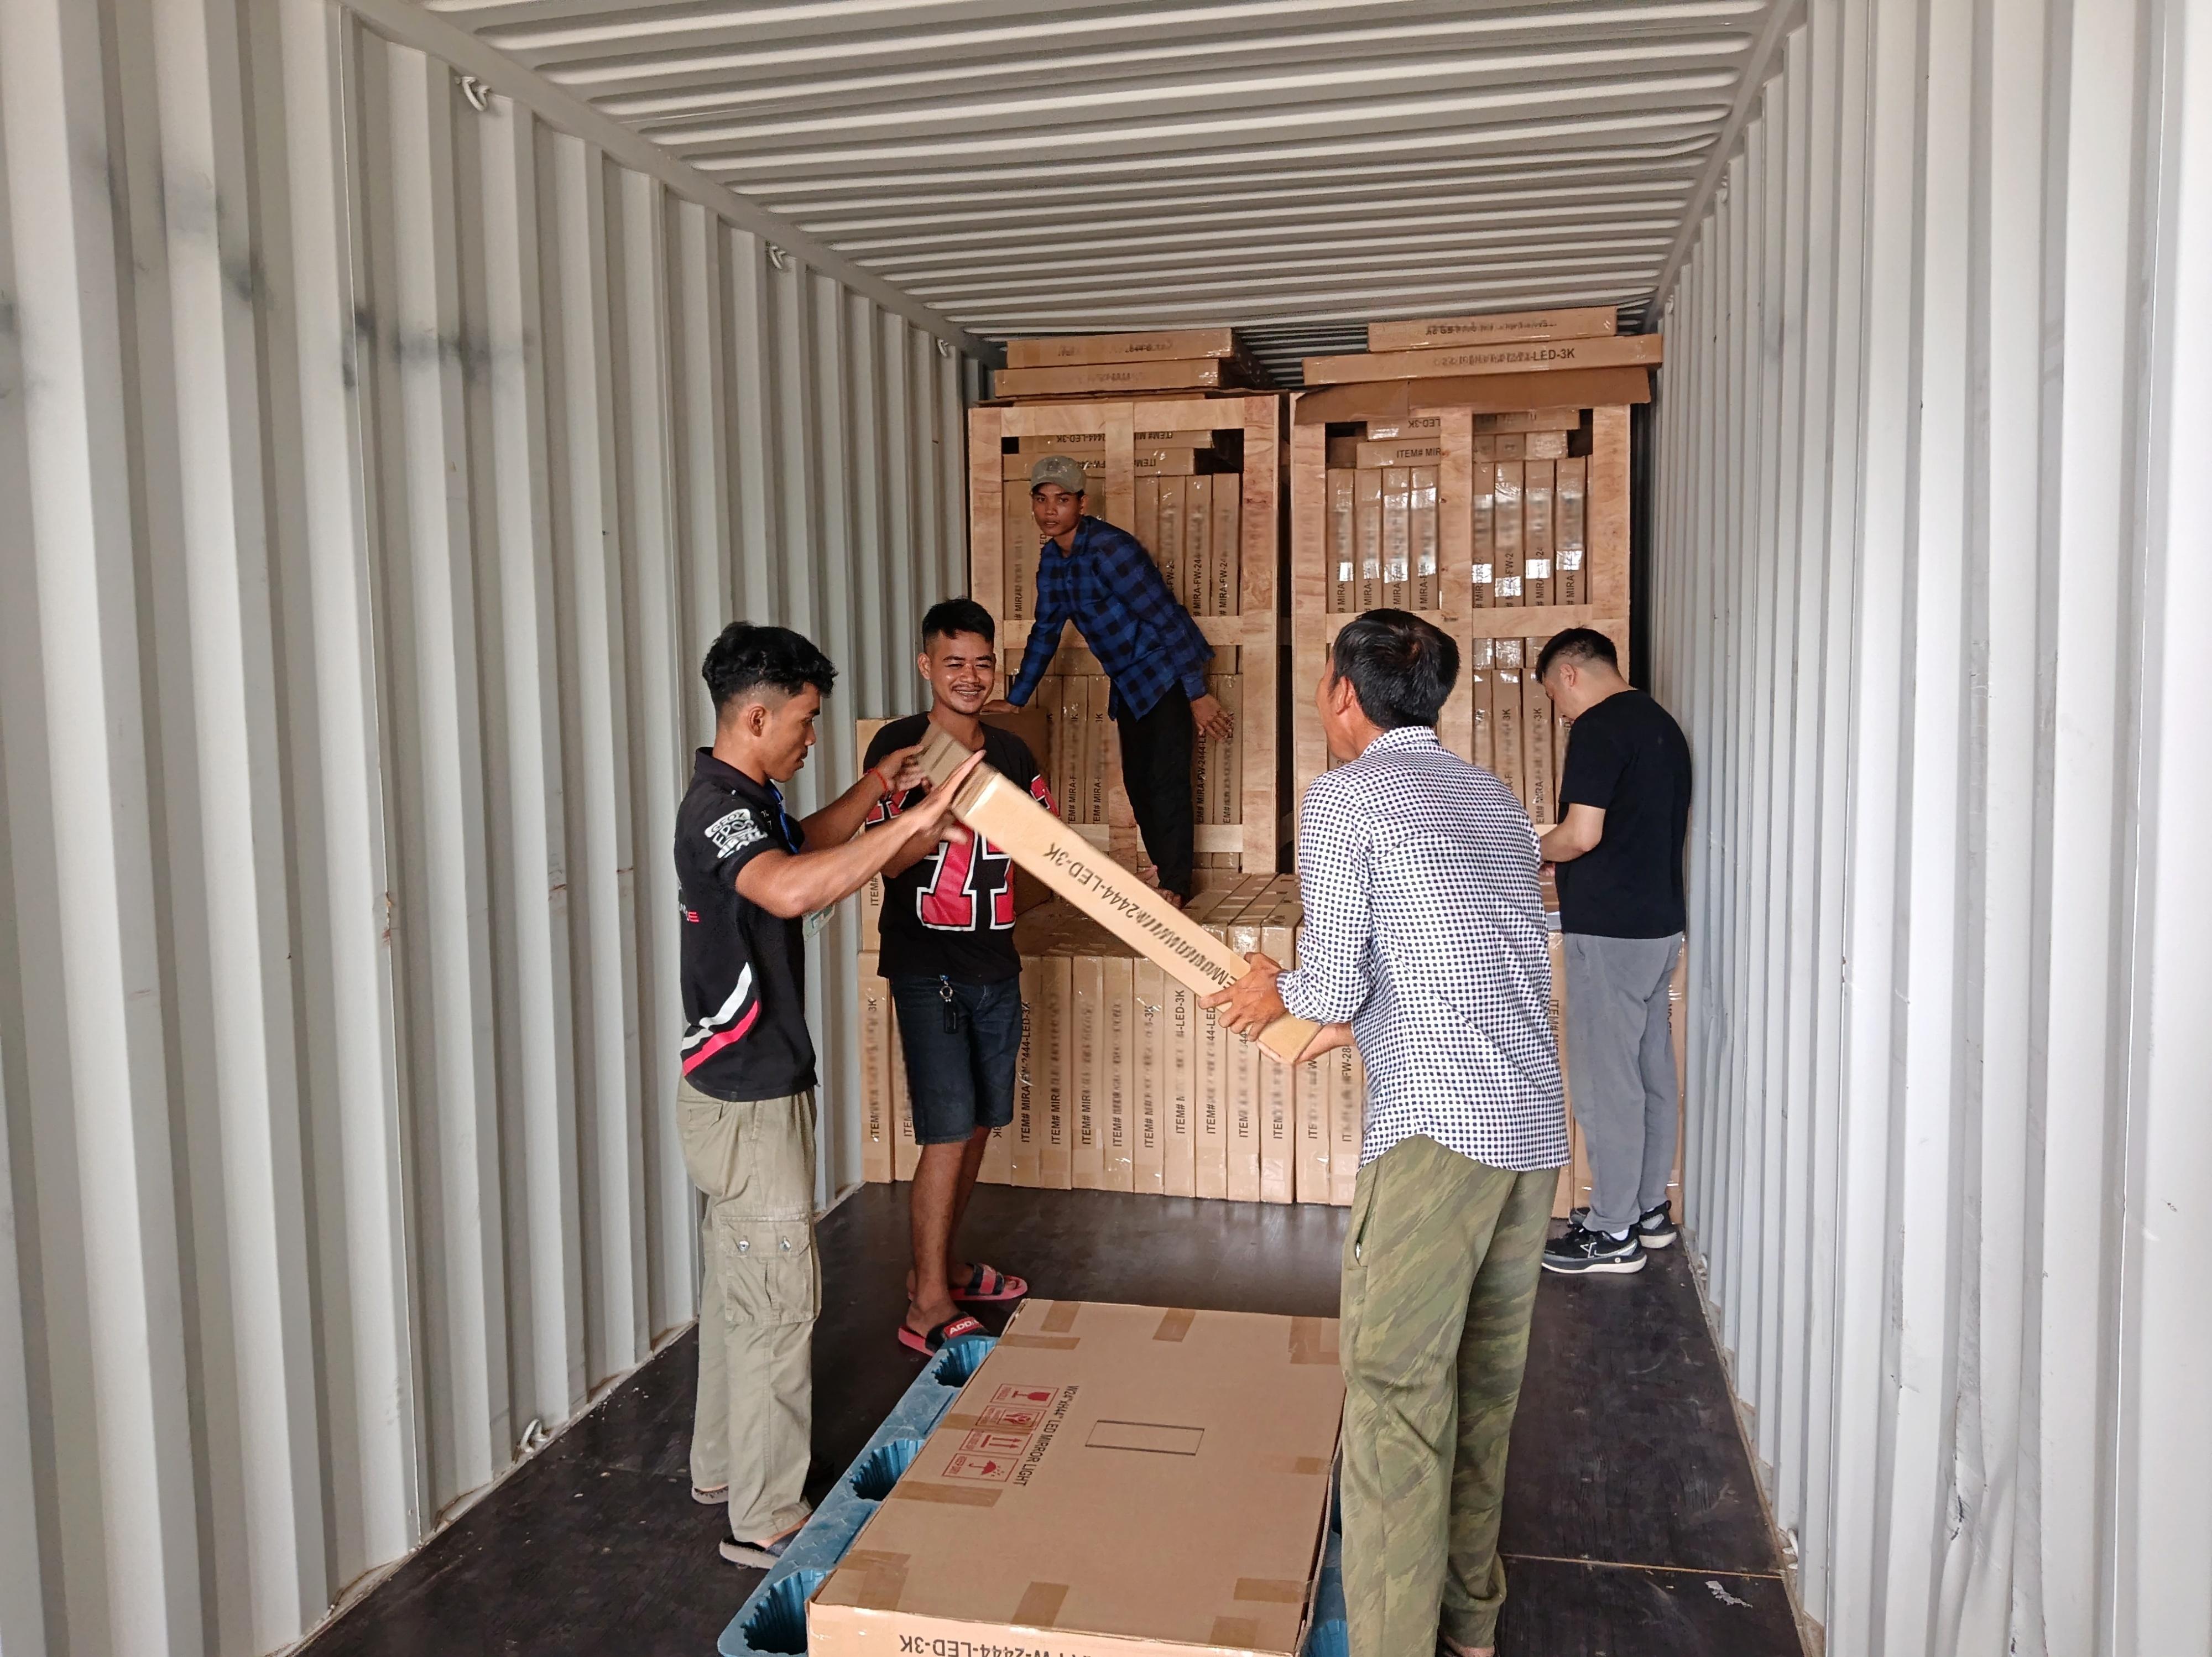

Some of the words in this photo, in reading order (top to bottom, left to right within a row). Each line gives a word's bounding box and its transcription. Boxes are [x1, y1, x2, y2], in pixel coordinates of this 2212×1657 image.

[1396, 449, 1423, 459] ITEM#
[870, 876, 879, 906] ITEM#
[1021, 1113, 1031, 1143] ITEM#
[1051, 1115, 1061, 1145] ITEM#
[1081, 1115, 1092, 1145] ITEM#
[1113, 1117, 1123, 1147] ITEM#
[1144, 1118, 1154, 1148] ITEM#
[1175, 1104, 1186, 1134] ITEM#
[1206, 1104, 1217, 1134] ITEM#
[1043, 1419, 1061, 1434] LED
[1026, 1434, 1053, 1462] MIRROR
[1013, 1464, 1036, 1487] LIGHT
